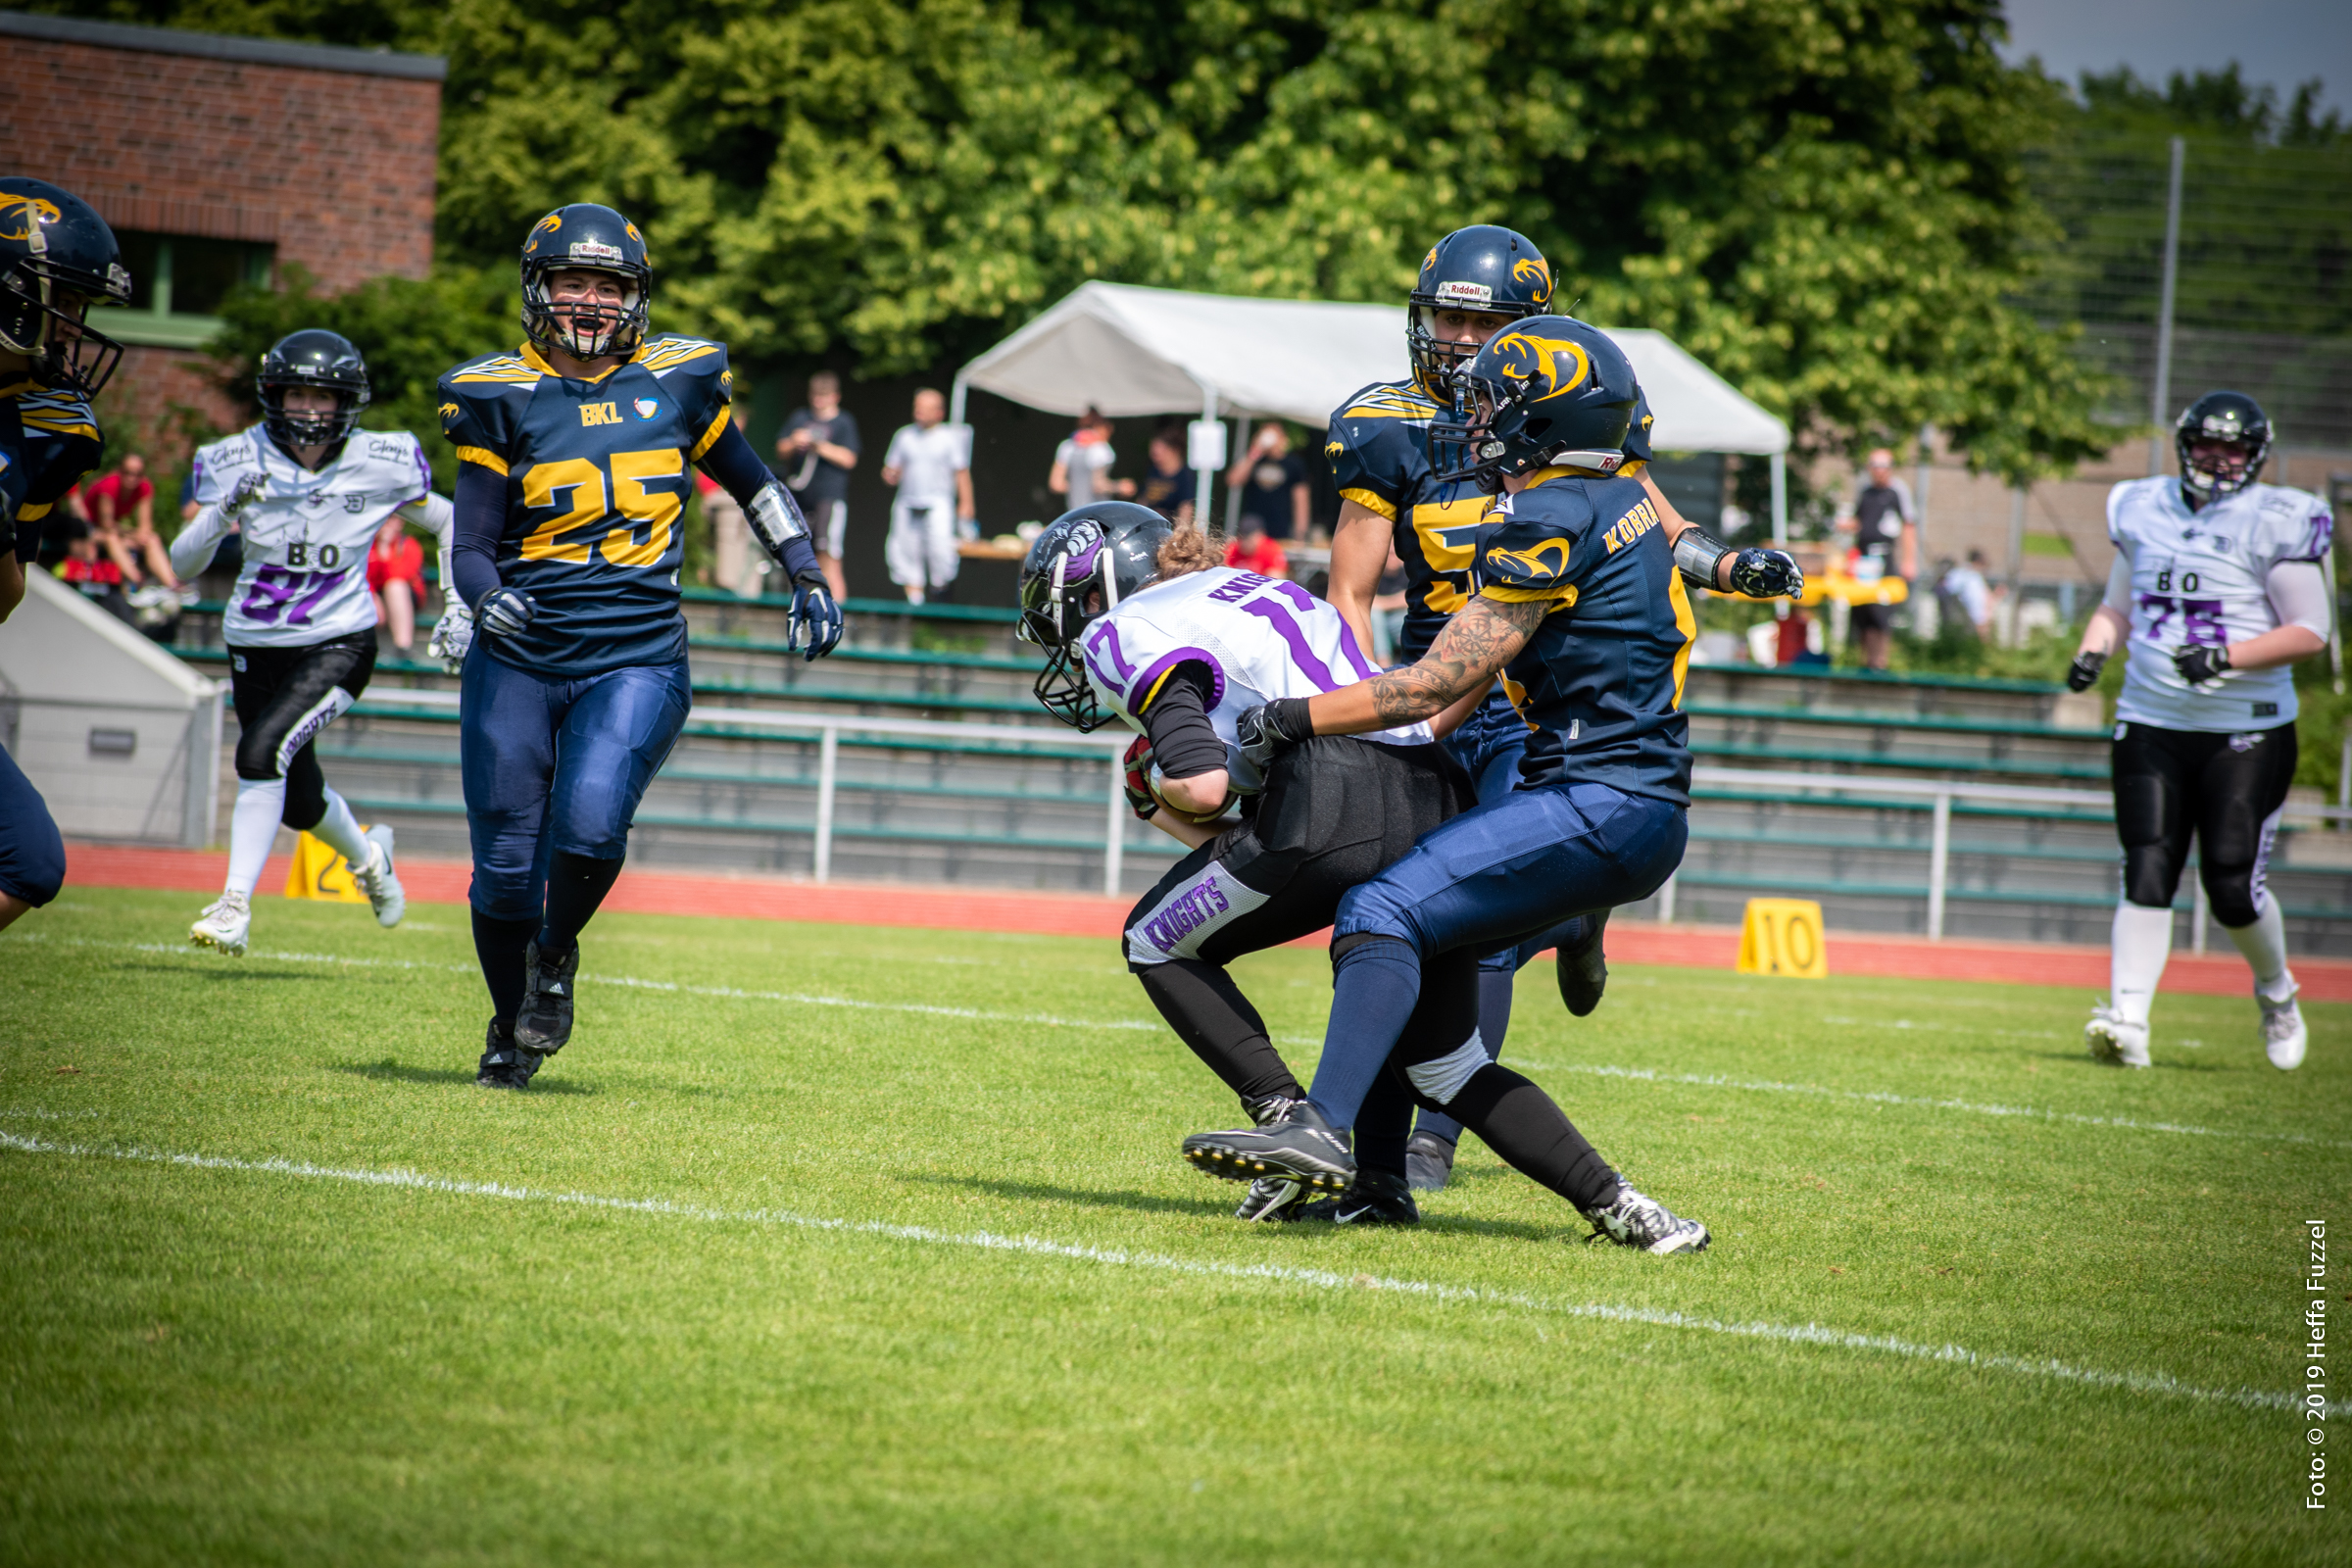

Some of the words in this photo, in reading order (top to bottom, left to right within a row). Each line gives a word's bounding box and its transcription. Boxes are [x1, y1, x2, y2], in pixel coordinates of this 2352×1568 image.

[581, 244, 611, 256] Riddell
[1450, 284, 1481, 296] Riddell
[578, 402, 623, 427] BKL
[517, 448, 684, 568] 25
[1601, 497, 1660, 555] KOBRA
[1412, 495, 1496, 615] 5
[241, 564, 346, 625] 87
[1206, 572, 1277, 604] KNIG
[1084, 619, 1138, 699] 17
[1239, 580, 1385, 694] 17
[1144, 875, 1230, 954] KNIGHTS
[1762, 913, 1816, 973] 10
